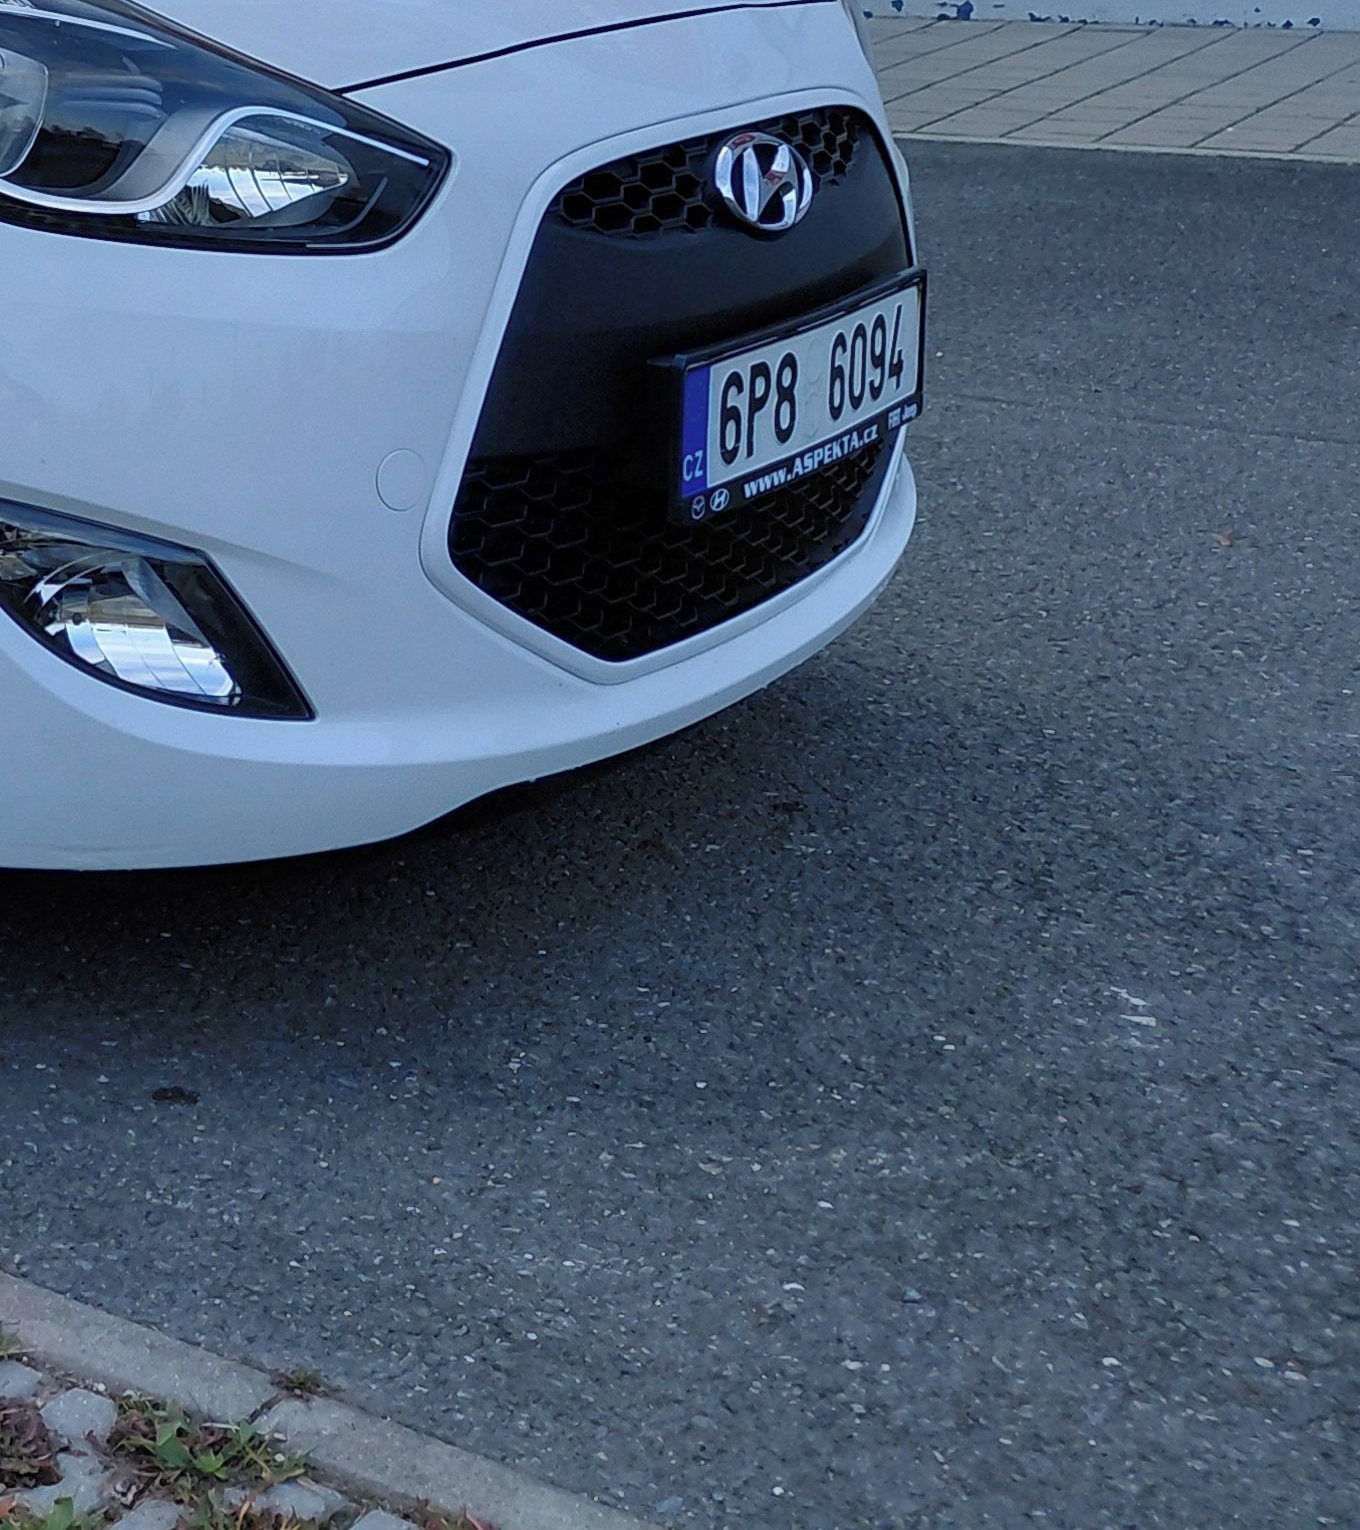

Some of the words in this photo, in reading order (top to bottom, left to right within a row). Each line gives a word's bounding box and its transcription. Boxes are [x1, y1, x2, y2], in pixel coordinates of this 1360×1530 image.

[719, 351, 799, 466] 6P8
[828, 303, 904, 421] 6094
[683, 450, 704, 482] CZ
